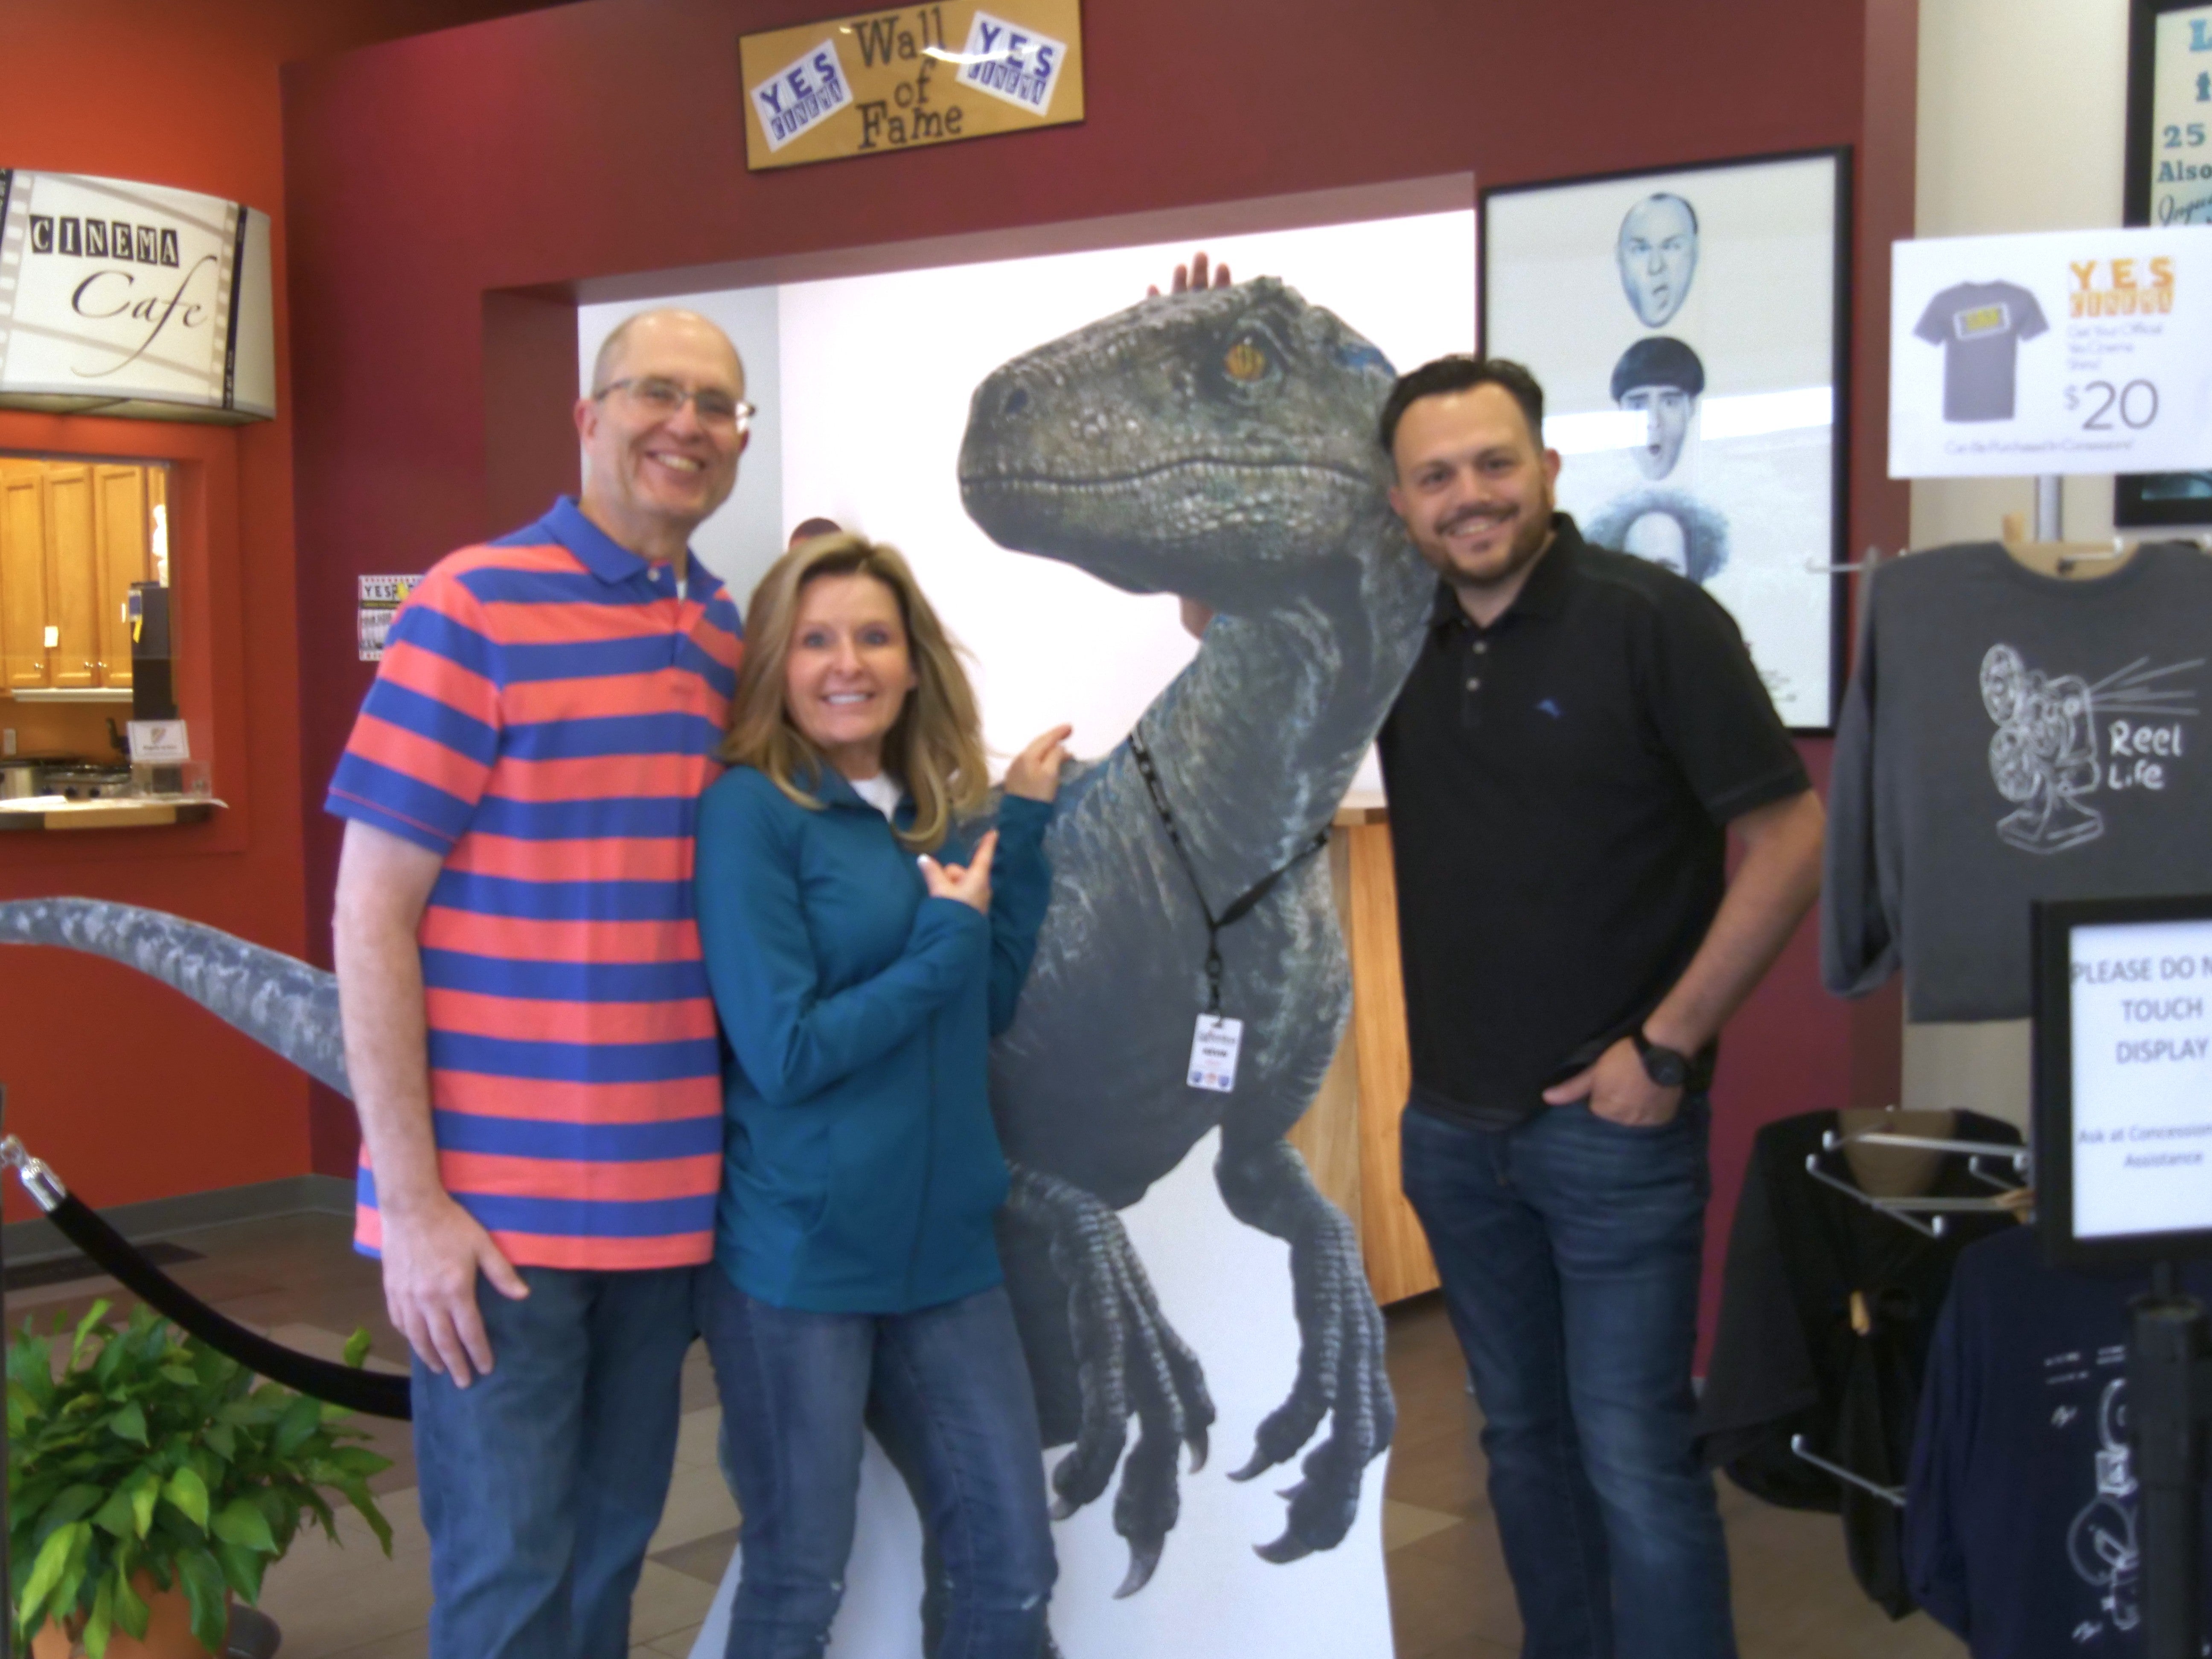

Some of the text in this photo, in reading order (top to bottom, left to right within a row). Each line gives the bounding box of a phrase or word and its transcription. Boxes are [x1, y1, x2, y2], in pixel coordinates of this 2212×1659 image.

[852, 5, 945, 67] Wall
[981, 22, 1053, 78] YES
[760, 52, 836, 114] YES
[894, 58, 936, 108] of
[856, 100, 963, 148] Fame
[2163, 123, 2205, 148] 25
[2157, 160, 2212, 183] Also
[31, 215, 178, 267] CINEMA
[2069, 256, 2174, 291] YES
[70, 255, 218, 378] Cafe
[2064, 379, 2159, 430] $20
[2109, 719, 2183, 757] Reel
[2107, 759, 2165, 790] Life
[2072, 957, 2152, 984] PLEASE
[2160, 955, 2195, 981] DO
[2121, 996, 2203, 1023] TOUCH
[2115, 1036, 2209, 1065] DISPLAY
